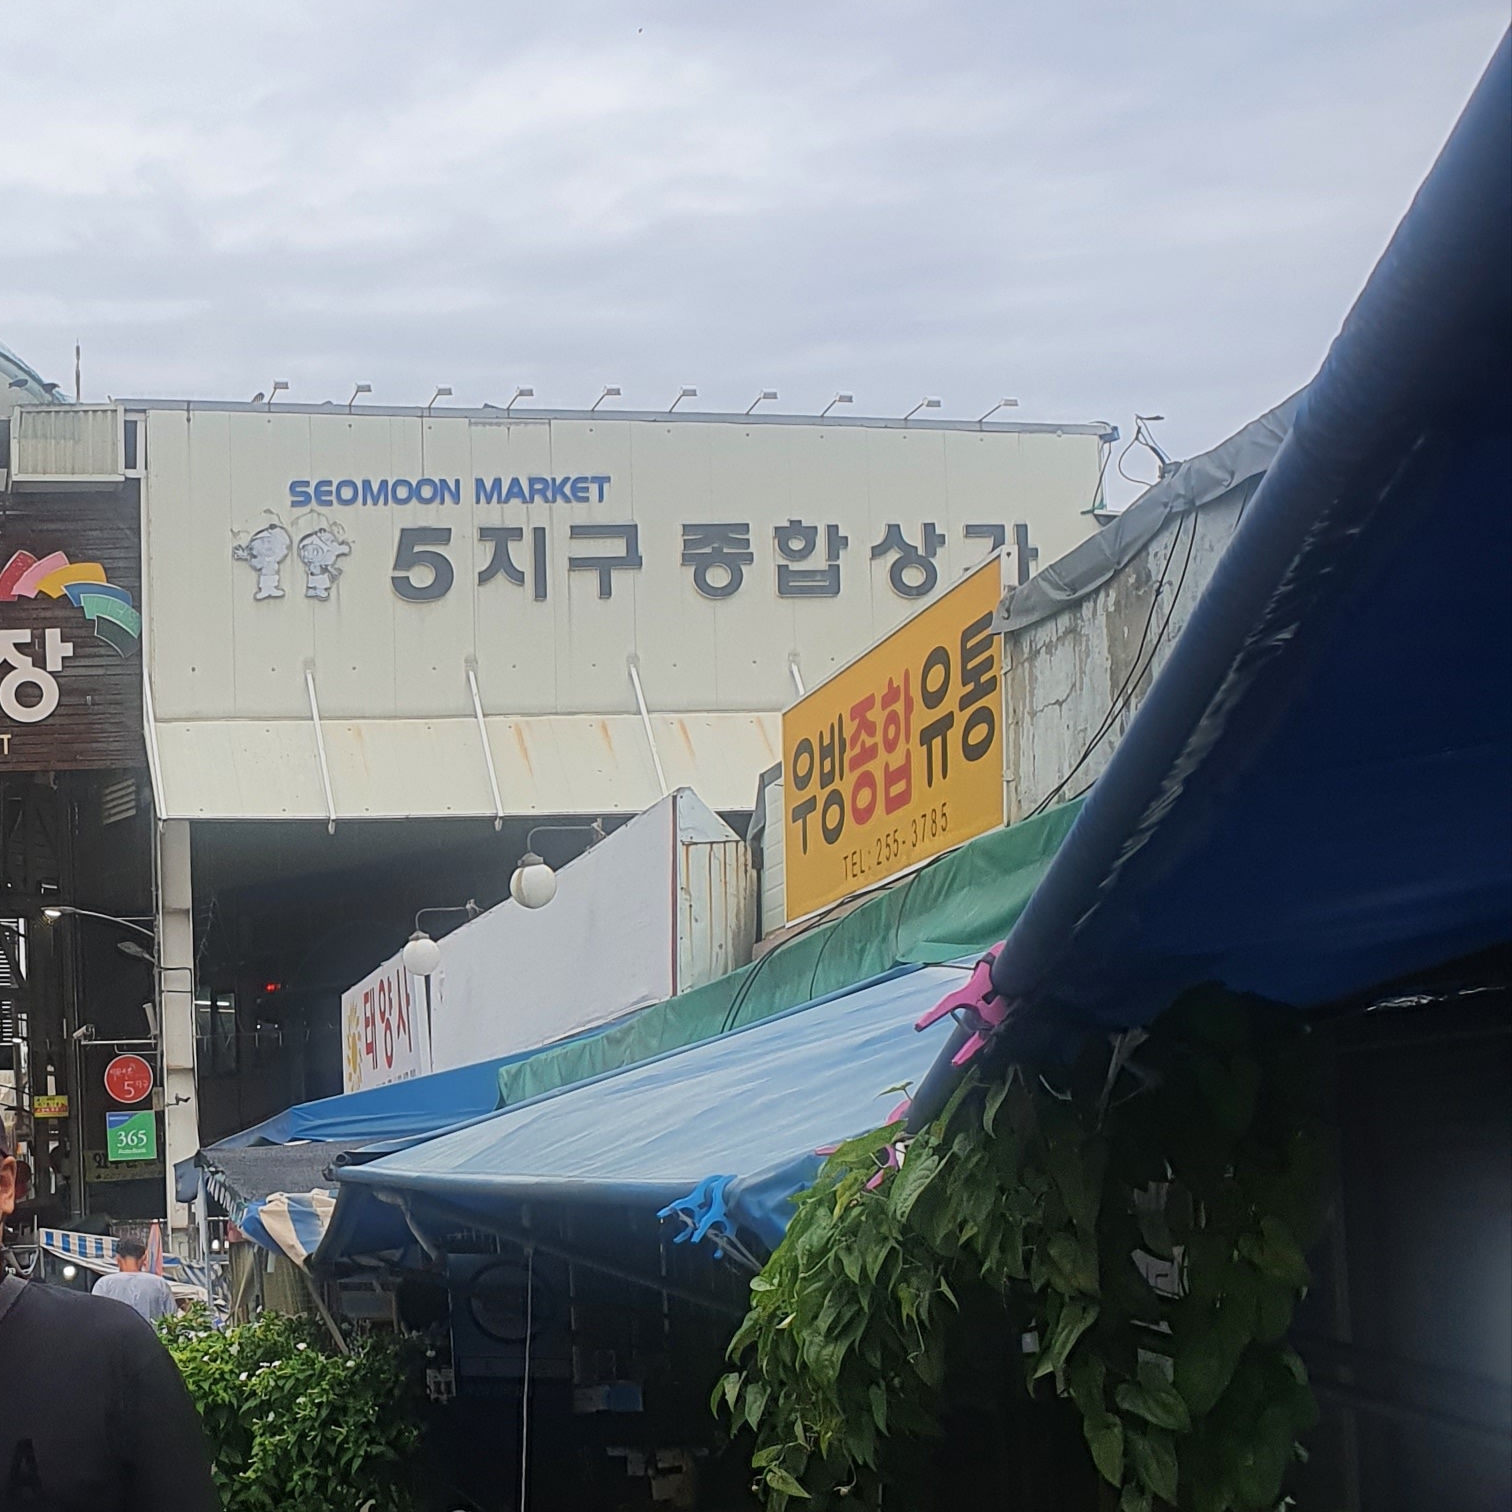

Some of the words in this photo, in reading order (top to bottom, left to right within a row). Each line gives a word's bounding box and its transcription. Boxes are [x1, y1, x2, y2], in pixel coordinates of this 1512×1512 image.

[289, 477, 460, 507] SEOMOON
[475, 475, 611, 504] MARKET
[390, 524, 642, 602] 5지구
[363, 965, 413, 1071] 태양사
[117, 1129, 147, 1147] 365
